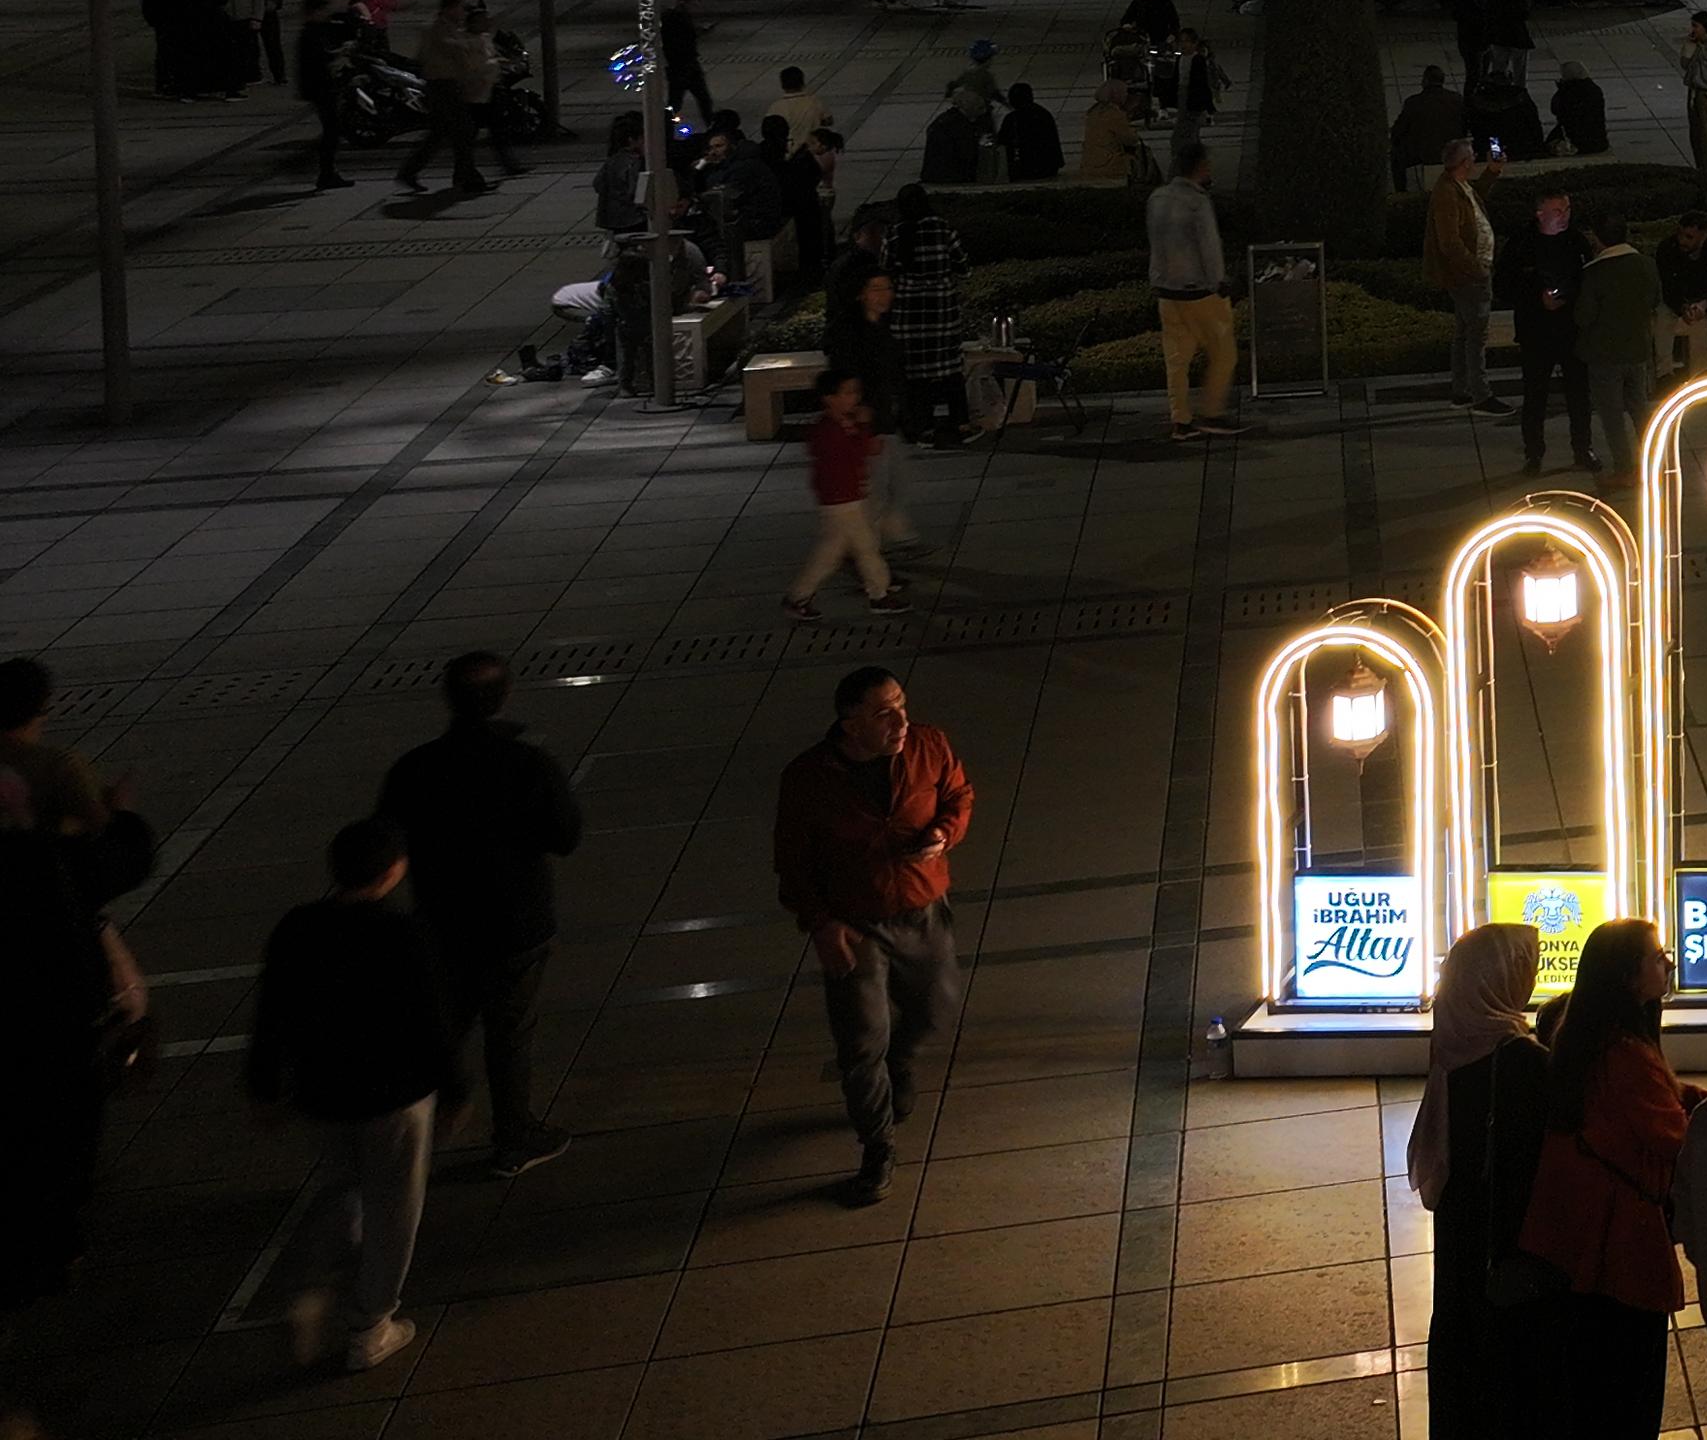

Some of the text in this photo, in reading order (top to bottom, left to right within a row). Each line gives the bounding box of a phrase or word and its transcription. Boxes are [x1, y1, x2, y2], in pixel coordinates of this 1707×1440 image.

[1328, 887, 1391, 907] UĞUR
[1303, 925, 1415, 978] Altay
[1538, 939, 1580, 952] ONYA
